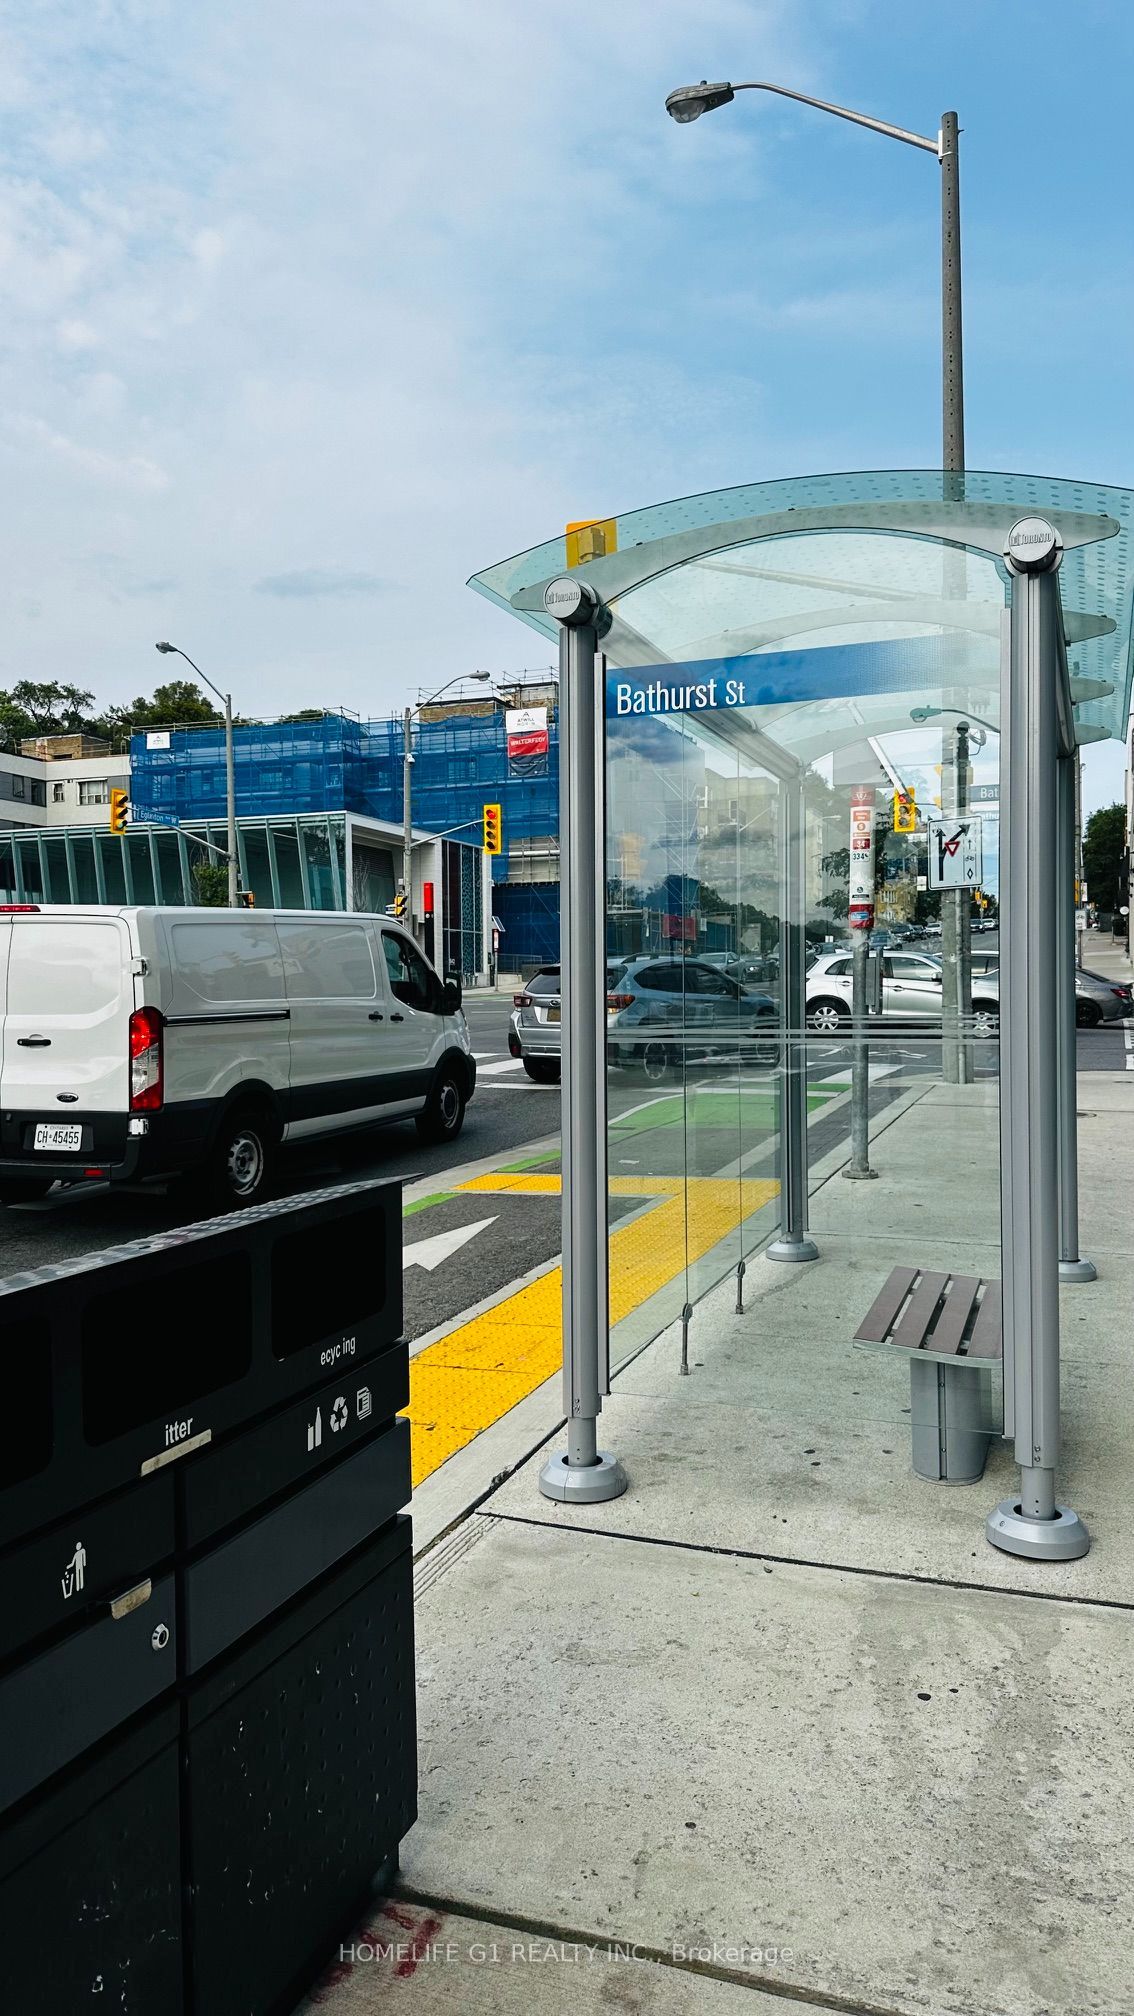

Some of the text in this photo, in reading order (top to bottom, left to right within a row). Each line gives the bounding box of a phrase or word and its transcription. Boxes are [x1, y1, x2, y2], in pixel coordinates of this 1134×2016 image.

[617, 679, 746, 715] Bathurst St
[37, 1130, 80, 1144] CH 45455
